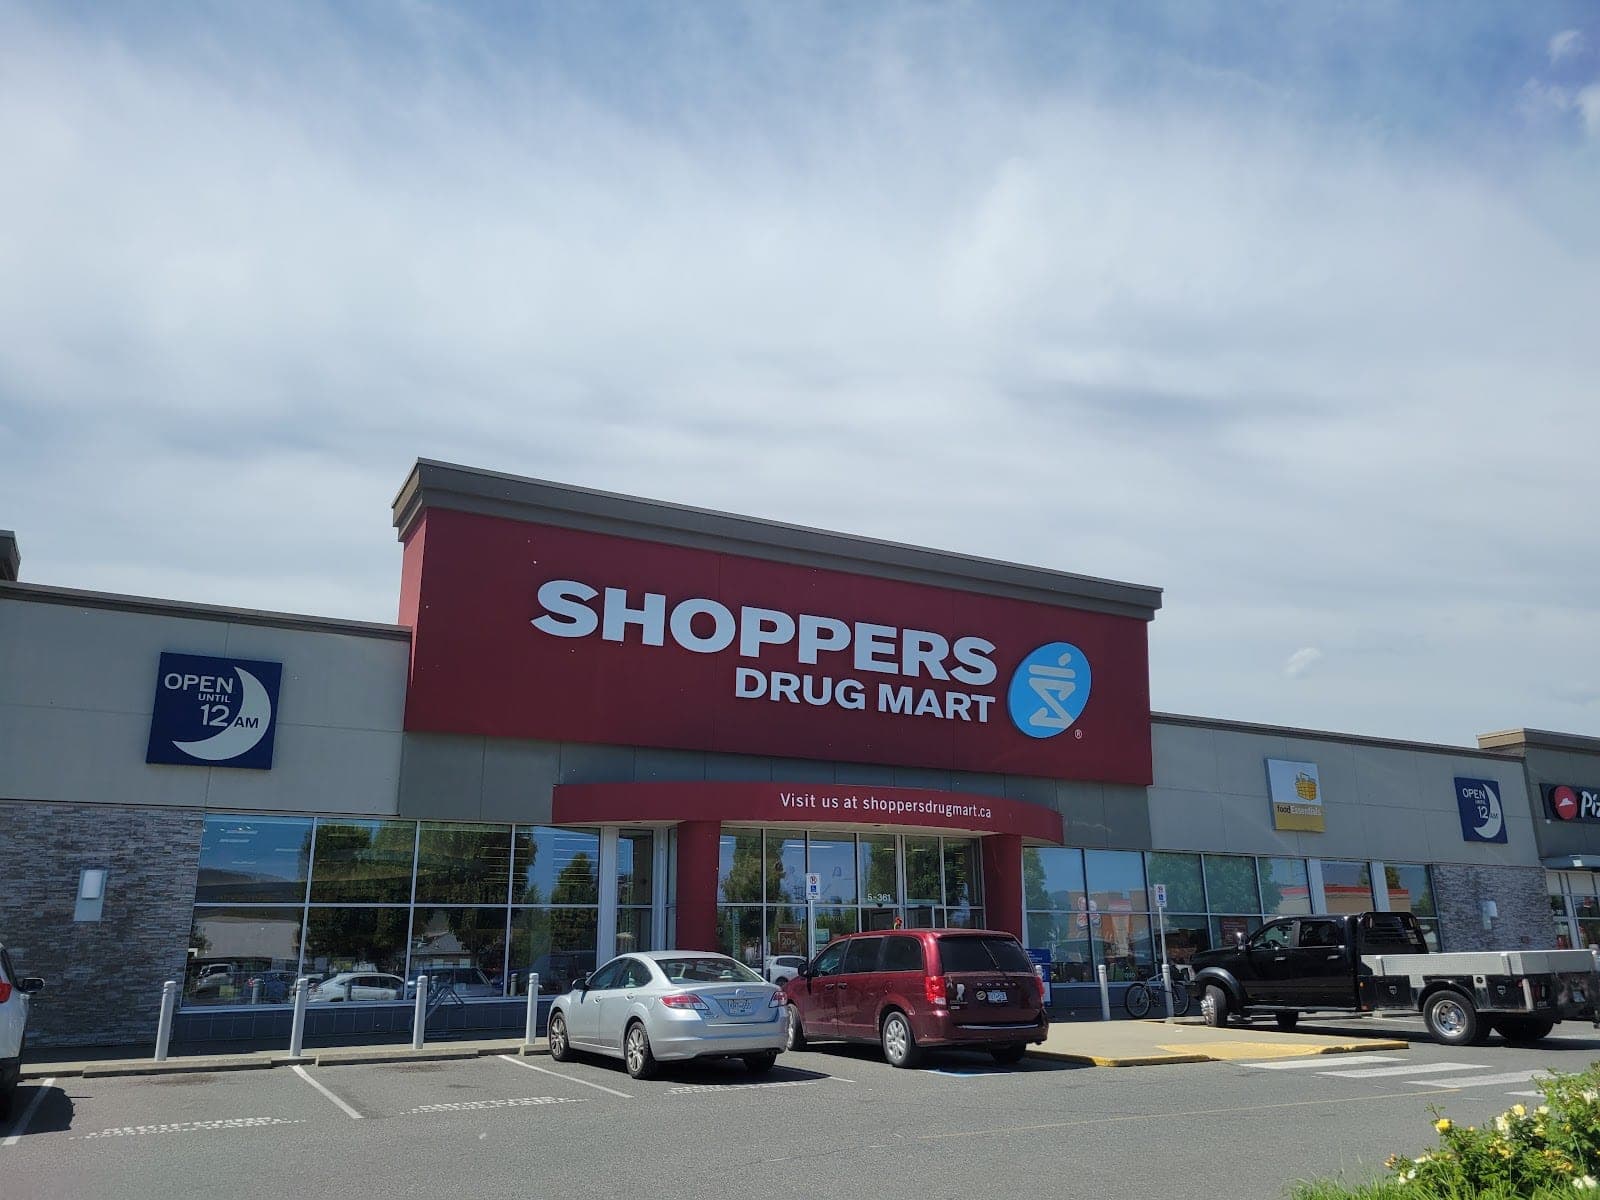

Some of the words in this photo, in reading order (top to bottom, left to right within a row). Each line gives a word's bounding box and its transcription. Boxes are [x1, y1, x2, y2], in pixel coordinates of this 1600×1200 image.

[530, 580, 998, 686] SHOPPERS
[164, 673, 234, 694] OPEN
[735, 667, 866, 710] DRUG
[877, 684, 996, 723] MART
[198, 693, 231, 703] UNTIL
[200, 704, 230, 728] 12
[234, 716, 259, 729] AM
[1462, 787, 1486, 799] OPEN
[780, 792, 816, 808] Visit
[822, 796, 839, 809] us
[844, 795, 858, 809] at
[863, 796, 992, 818] shoppersdrugmart.ca
[1477, 805, 1489, 819] 12
